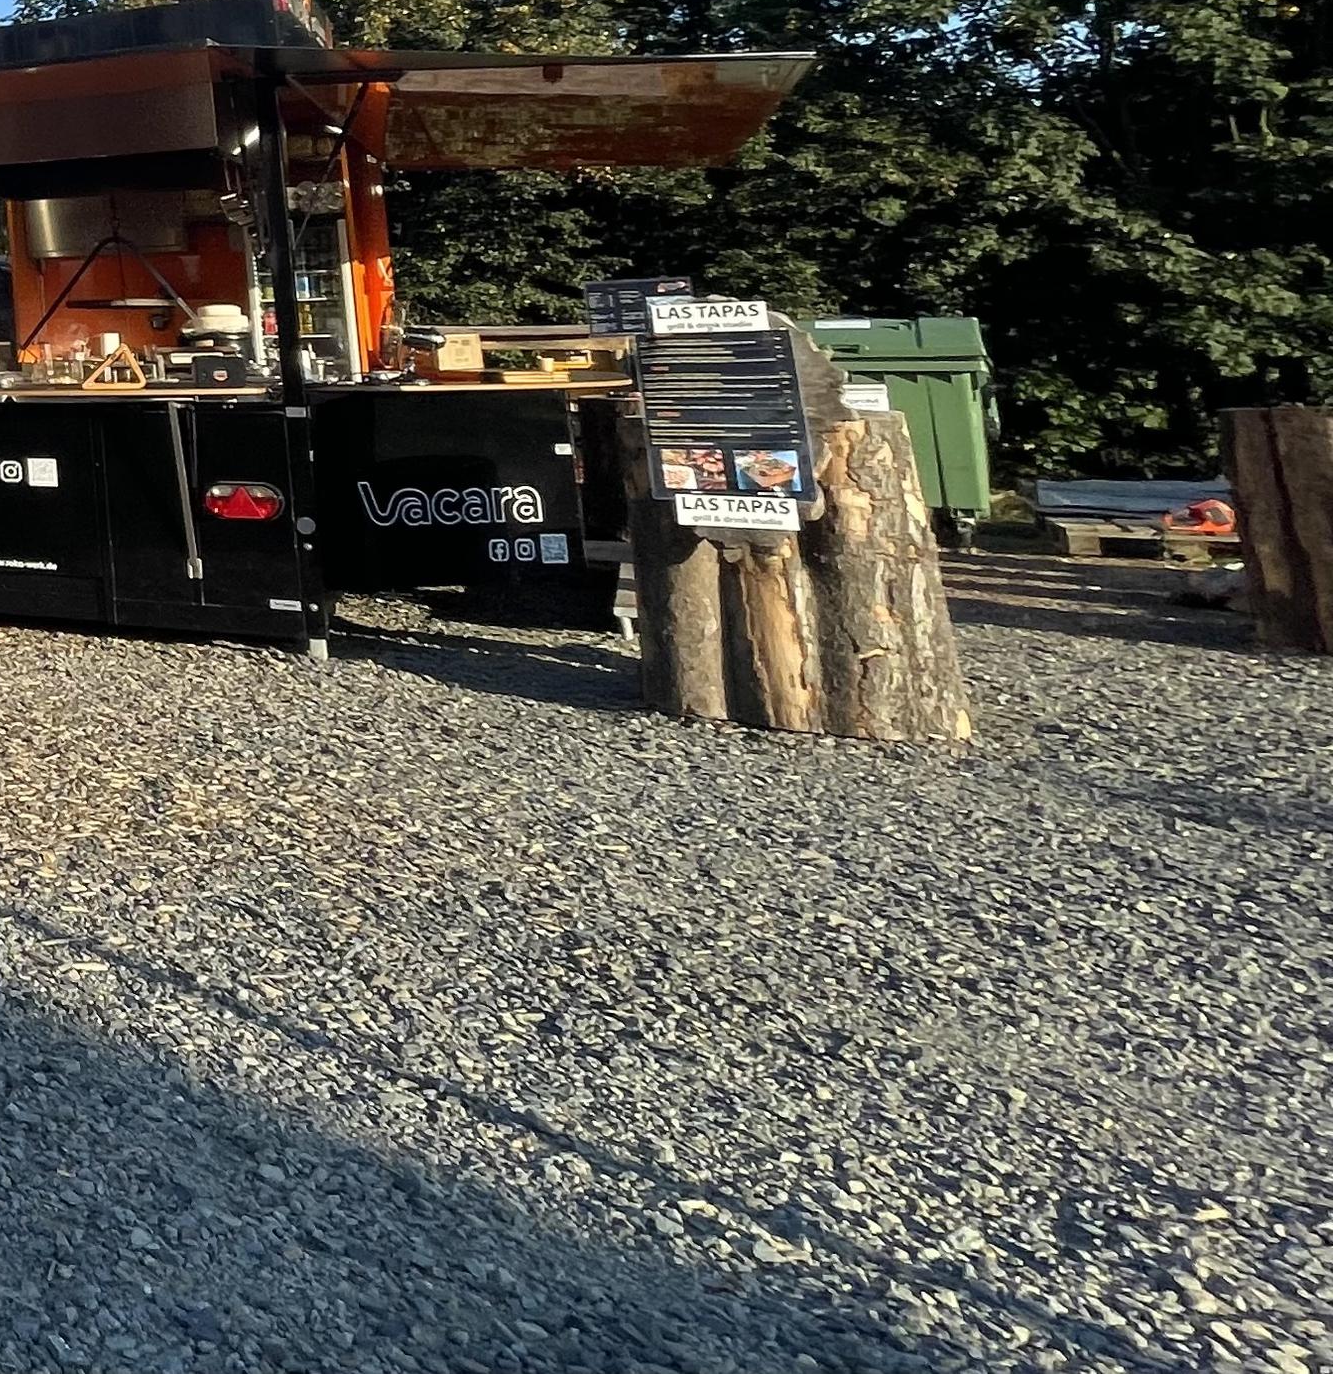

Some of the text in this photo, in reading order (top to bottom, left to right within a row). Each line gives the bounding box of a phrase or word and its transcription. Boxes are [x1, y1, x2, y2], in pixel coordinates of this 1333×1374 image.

[656, 304, 760, 320] LAS TAPAS
[682, 496, 790, 515] LAS TAPAS
[692, 514, 712, 523] grill
